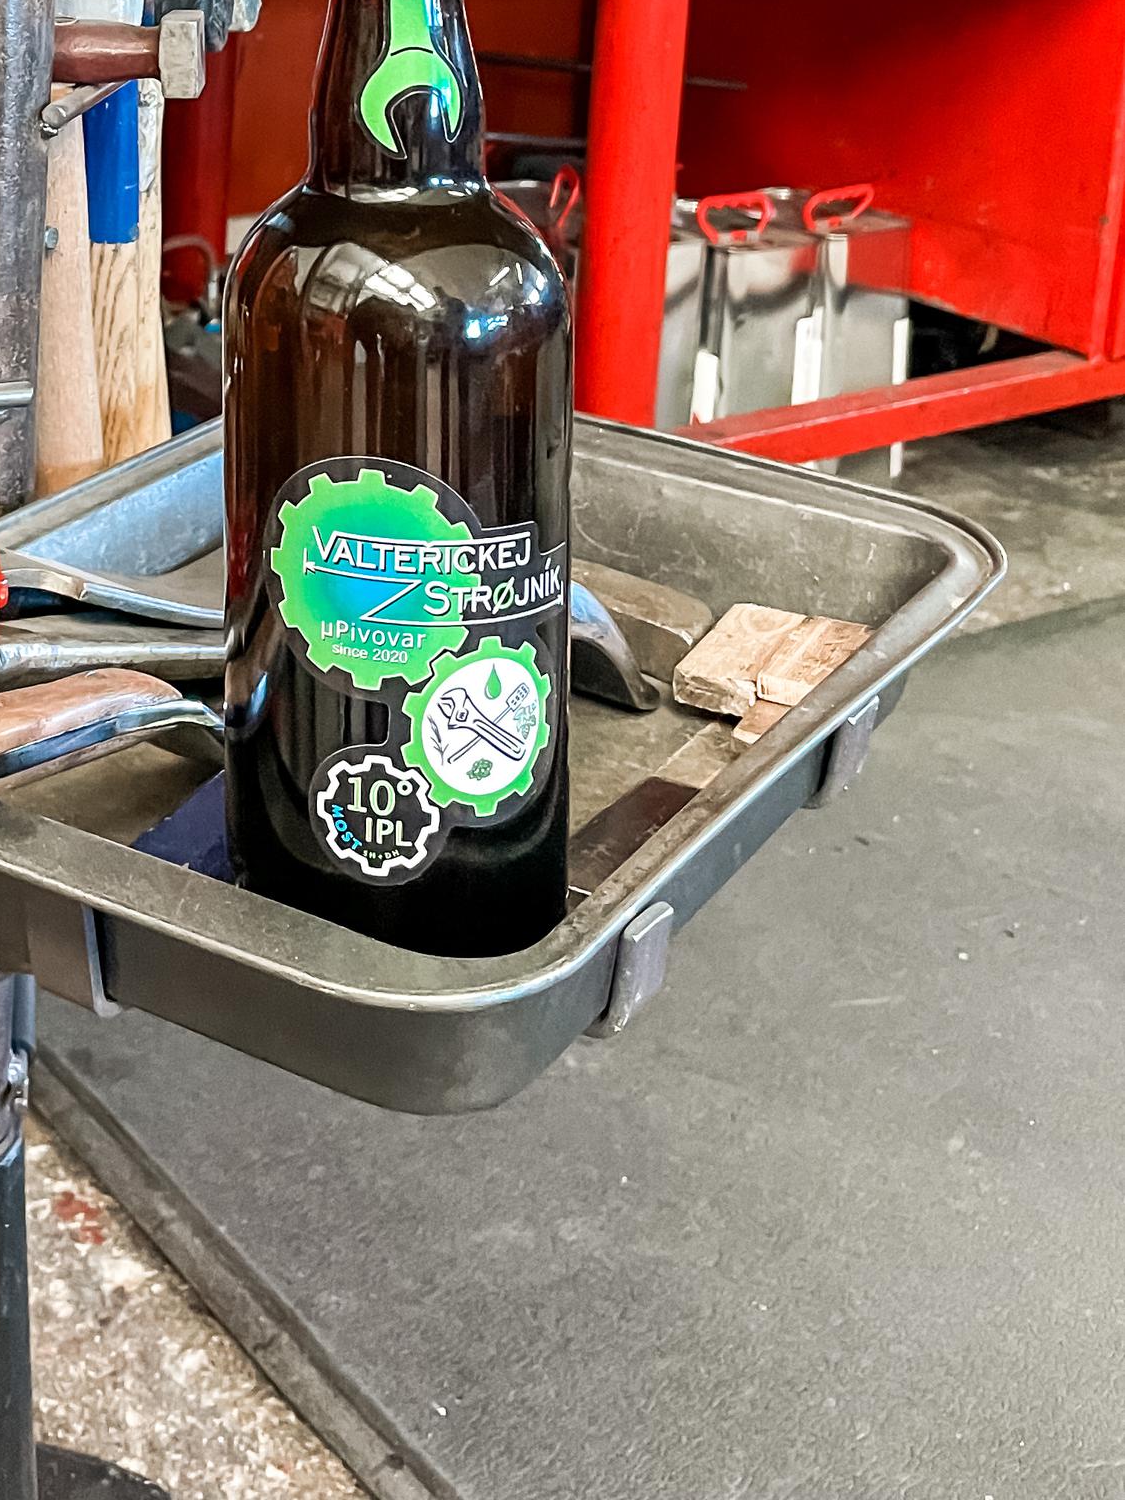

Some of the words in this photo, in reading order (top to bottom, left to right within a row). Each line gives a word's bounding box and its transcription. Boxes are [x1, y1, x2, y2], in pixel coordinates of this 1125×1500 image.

[332, 642, 368, 659] since
[372, 648, 408, 664] 2020
[331, 804, 363, 851] MOST
[365, 816, 413, 847] IPL
